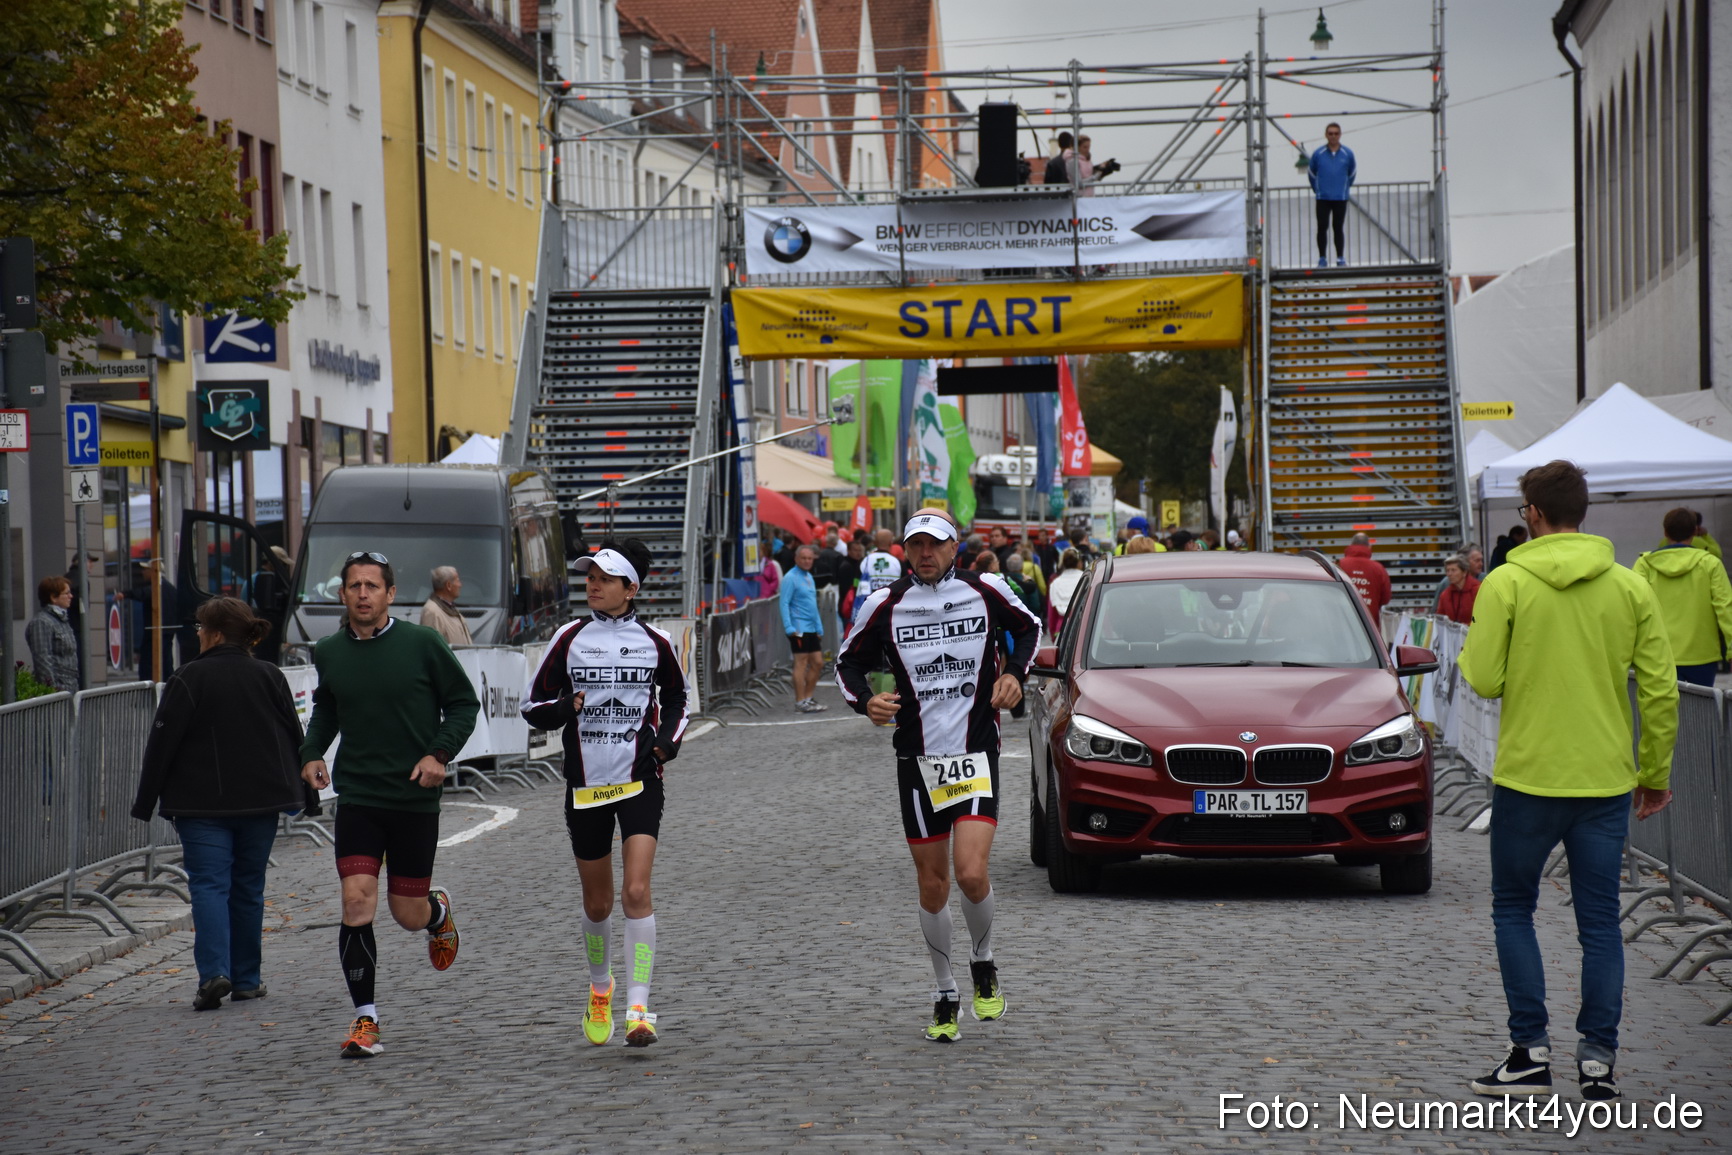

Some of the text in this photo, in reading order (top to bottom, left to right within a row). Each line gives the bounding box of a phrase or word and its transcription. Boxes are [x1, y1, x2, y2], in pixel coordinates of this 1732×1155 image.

[876, 225, 921, 239] BMW
[876, 242, 928, 253] WENGER
[930, 240, 1003, 251] VERBRAUCH.
[1005, 239, 1038, 249] MEHR
[899, 295, 1072, 338] START
[1167, 309, 1213, 319] Stadtlauf
[1463, 407, 1506, 416] Toiletten
[73, 411, 91, 458] P
[99, 448, 150, 459] Toiletten
[1166, 509, 1175, 522] C
[898, 618, 983, 641] POSITIV
[915, 660, 975, 675] WOLFRUM
[572, 668, 652, 682] POSITIV
[917, 671, 976, 682] BAUUNTERNEHMEN
[918, 686, 959, 697] BRÖTJE
[583, 707, 641, 717] WOLFRUM
[581, 730, 624, 738] BRÖTJE
[933, 758, 976, 786] 246
[593, 786, 624, 801] Angela
[946, 783, 973, 798] Werner
[1207, 793, 1238, 811] PAR
[1251, 793, 1271, 811] TL
[1275, 793, 1305, 811] 157
